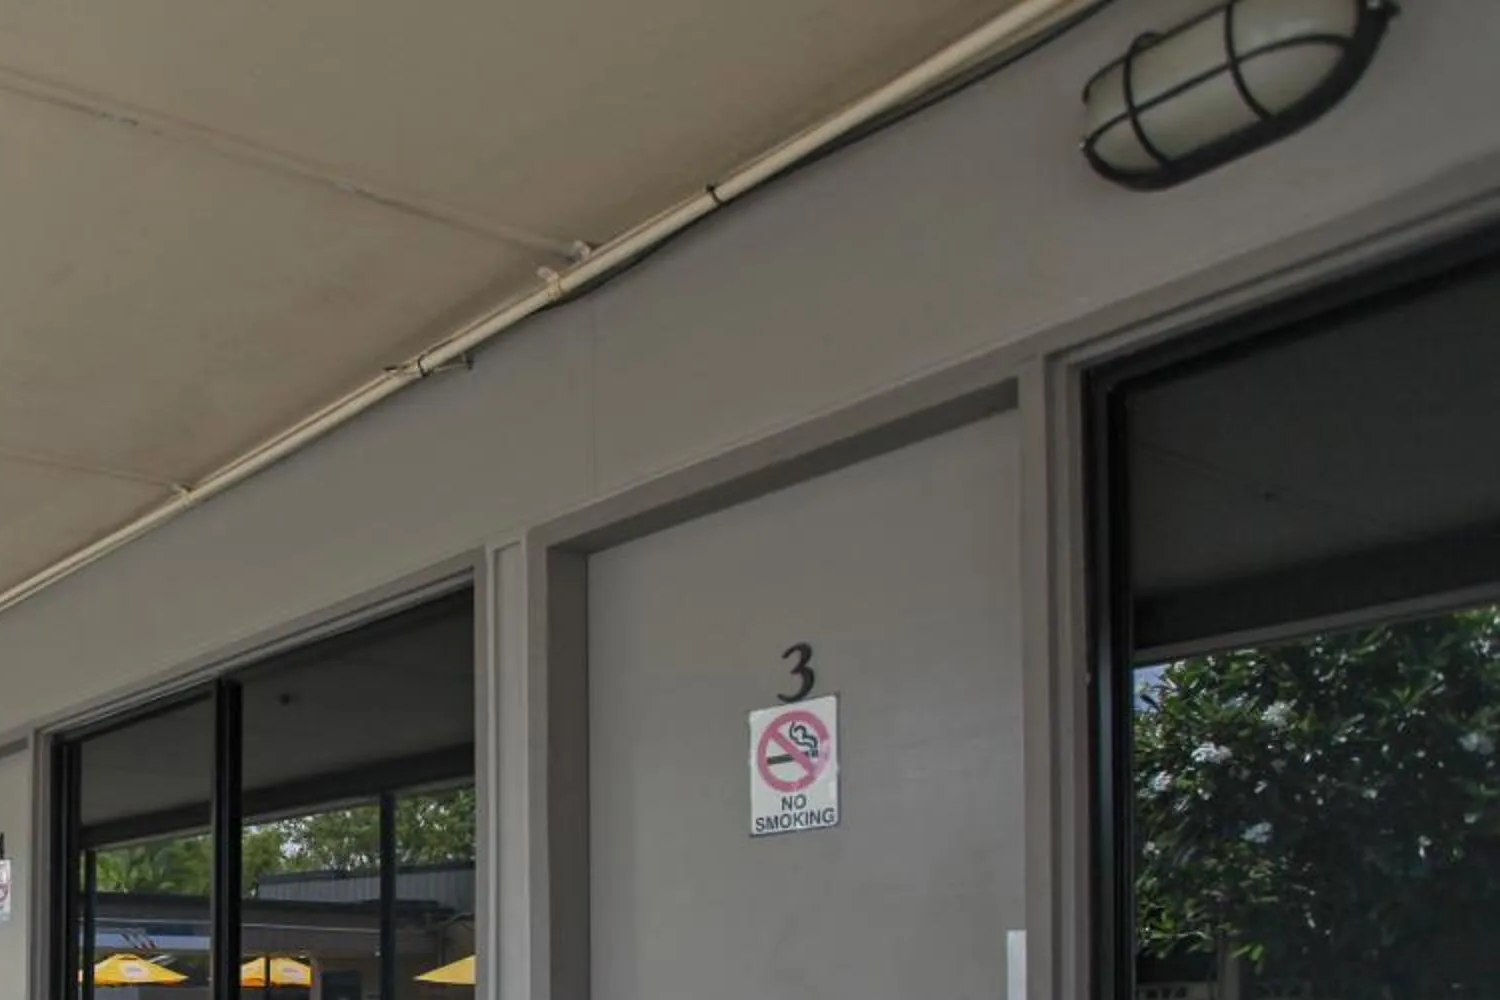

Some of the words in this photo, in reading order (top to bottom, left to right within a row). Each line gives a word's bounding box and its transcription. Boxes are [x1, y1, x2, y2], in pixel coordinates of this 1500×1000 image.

[777, 642, 815, 702] 3
[781, 794, 807, 811] NO
[755, 807, 835, 832] SMOKING
